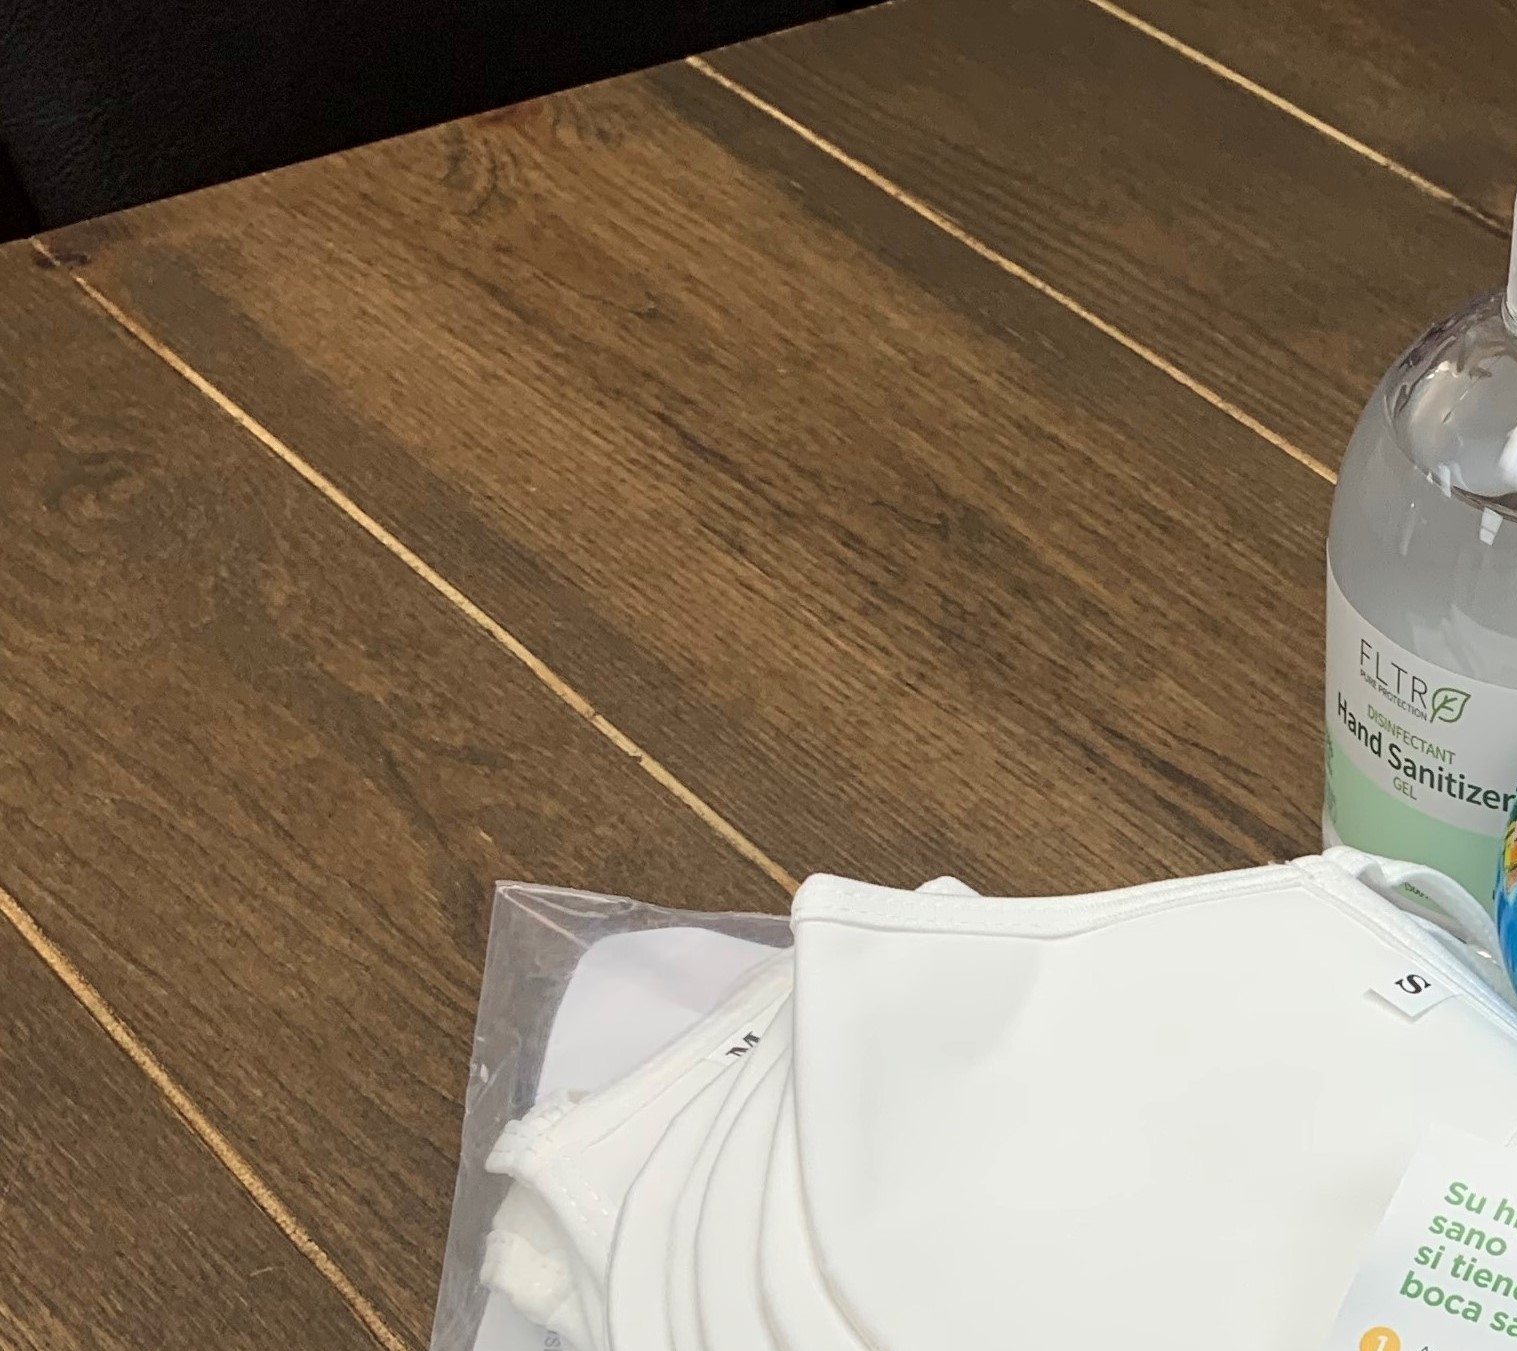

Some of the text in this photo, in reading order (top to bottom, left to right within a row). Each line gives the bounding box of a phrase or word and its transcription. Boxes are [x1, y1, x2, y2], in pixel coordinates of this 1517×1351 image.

[1360, 639, 1428, 709] FLTR
[1360, 669, 1427, 722] PURE PROTECTION
[1337, 691, 1382, 758] Hand
[1388, 743, 1515, 813] Sanitizer
[1367, 704, 1456, 765] DISINFECTANT
[1393, 776, 1417, 800] GEL
[1395, 974, 1431, 994] S
[1443, 1181, 1487, 1215] Su
[1413, 1245, 1446, 1270] si
[1428, 1215, 1508, 1258] sano
[1399, 1270, 1483, 1324] boca
